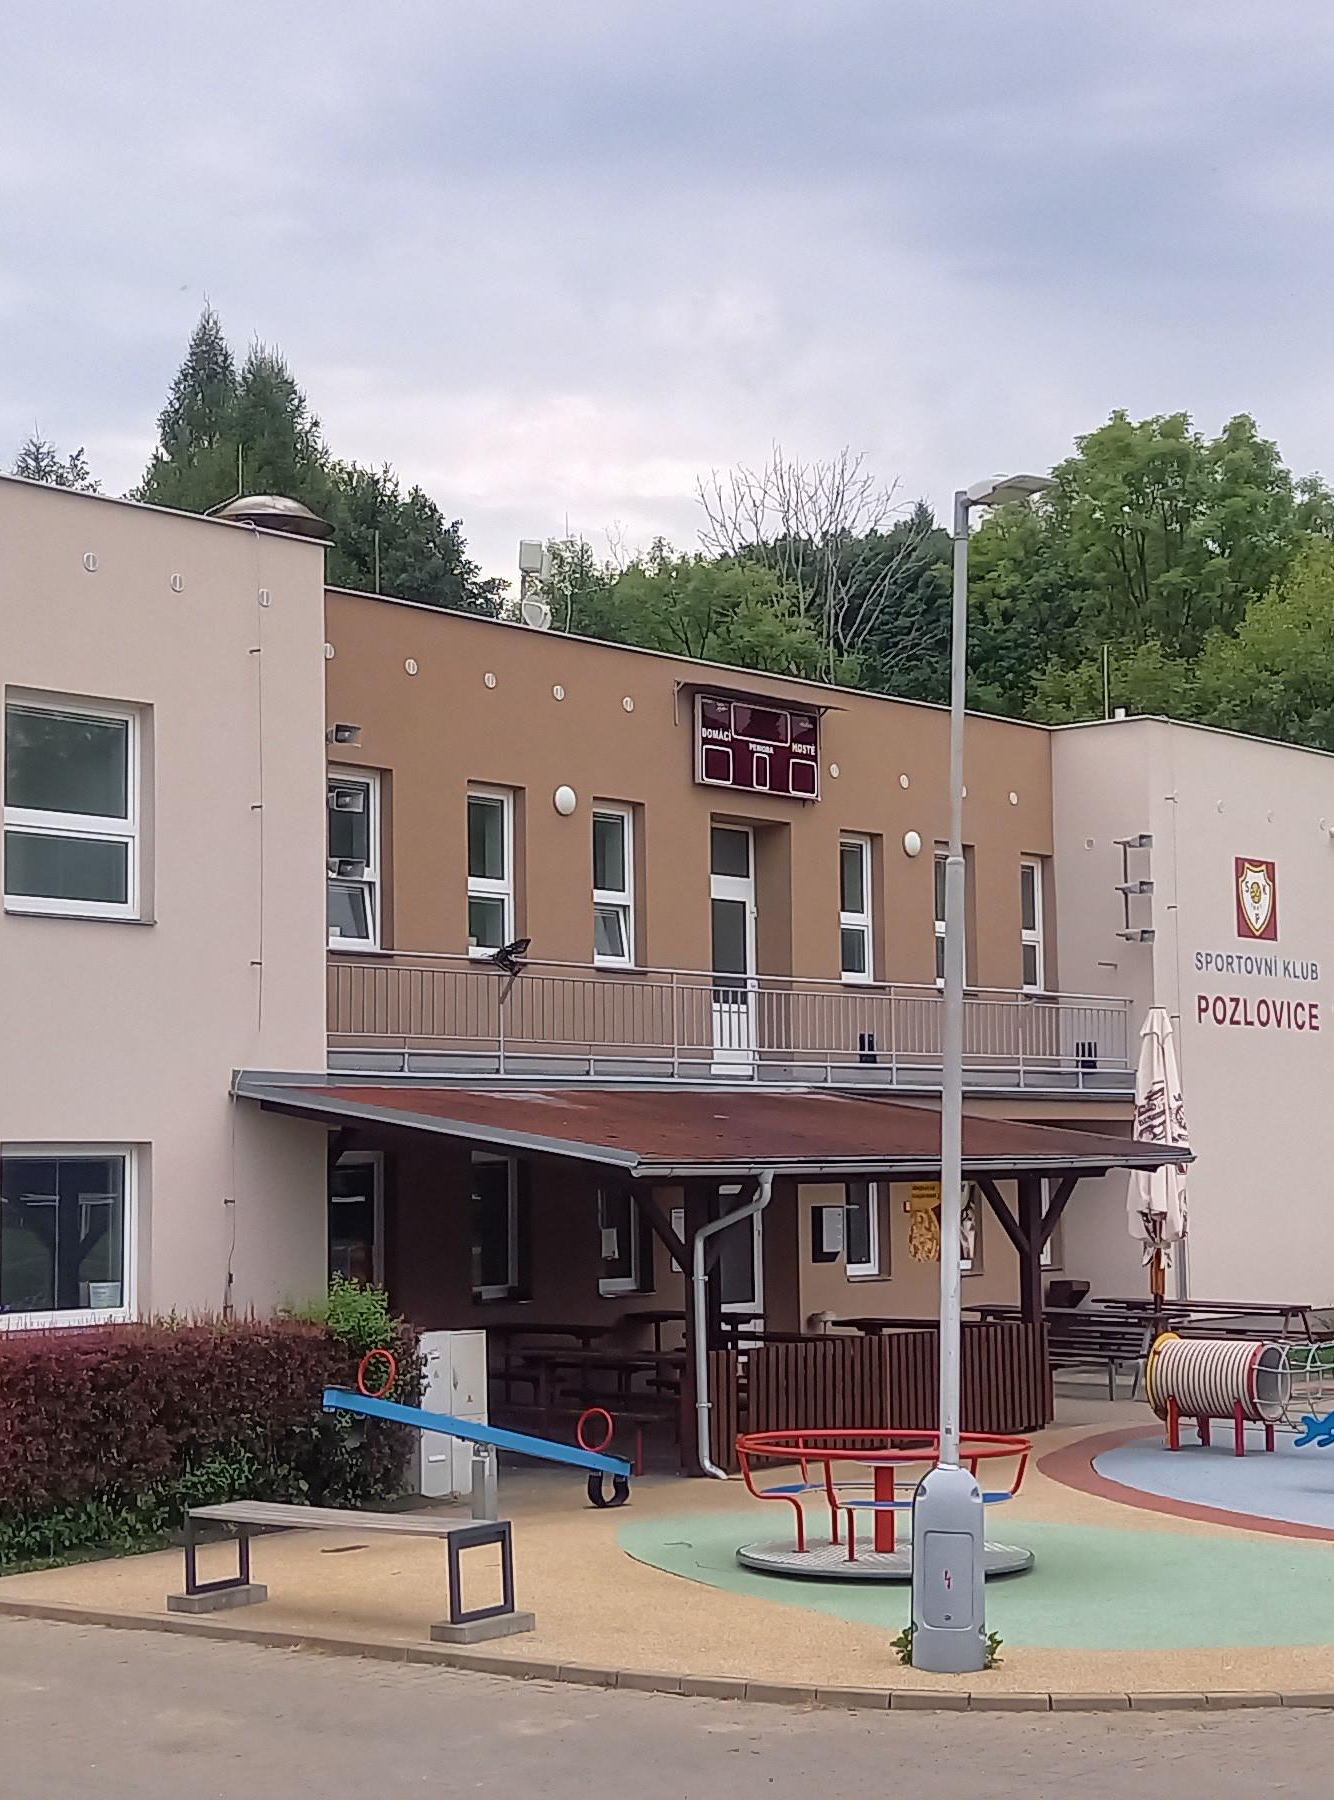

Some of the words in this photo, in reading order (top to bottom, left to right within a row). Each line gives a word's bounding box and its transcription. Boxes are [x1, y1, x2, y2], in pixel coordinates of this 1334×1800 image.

[702, 728, 732, 742] DOMÁCÍ
[1195, 951, 1278, 977] SPORTOVNÍ
[1283, 959, 1319, 981] KLUB
[1197, 994, 1320, 1031] POZLOVICE
